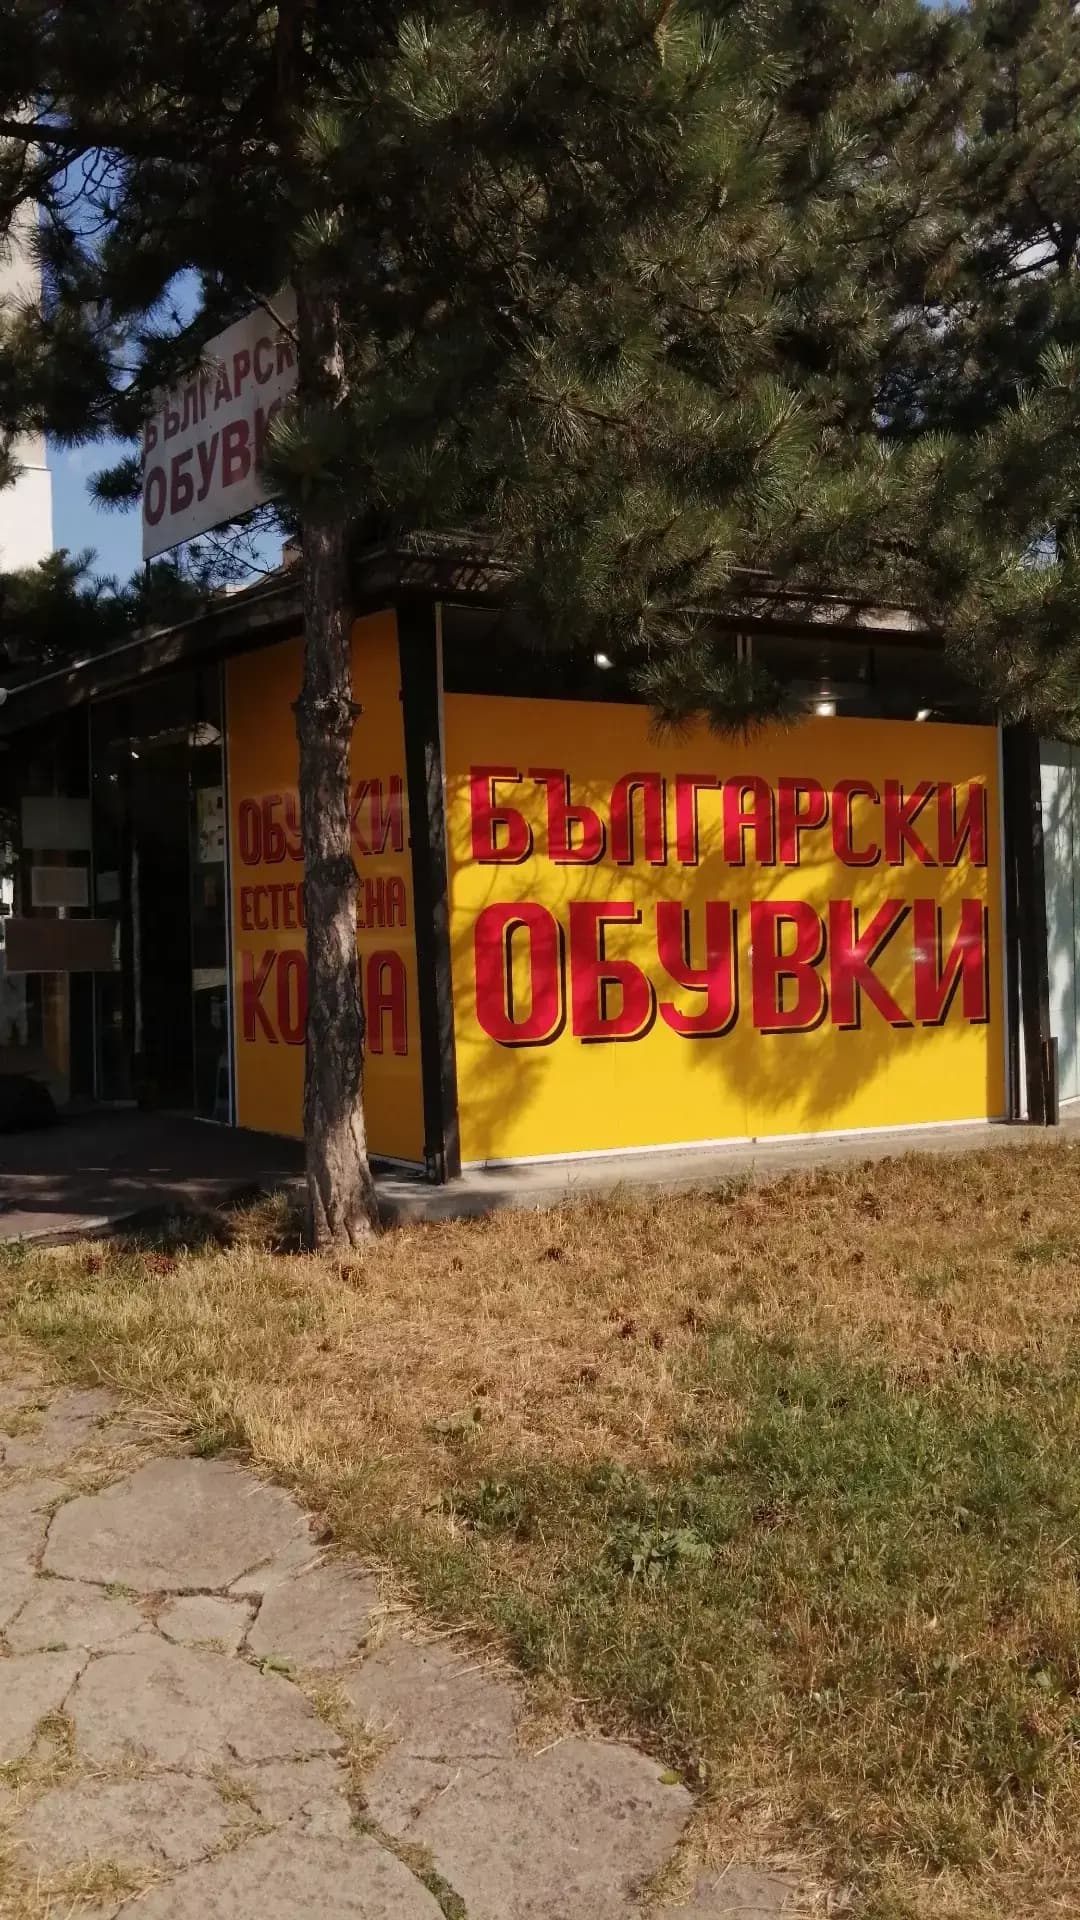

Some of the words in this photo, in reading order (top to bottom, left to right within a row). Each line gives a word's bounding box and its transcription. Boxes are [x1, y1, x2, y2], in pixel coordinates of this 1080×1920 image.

[238, 775, 403, 865] ОБУКИ
[470, 765, 988, 867] БЪЛГАРСКИ
[241, 950, 408, 1056] КОА
[474, 898, 990, 1048] ОБУВКИ
